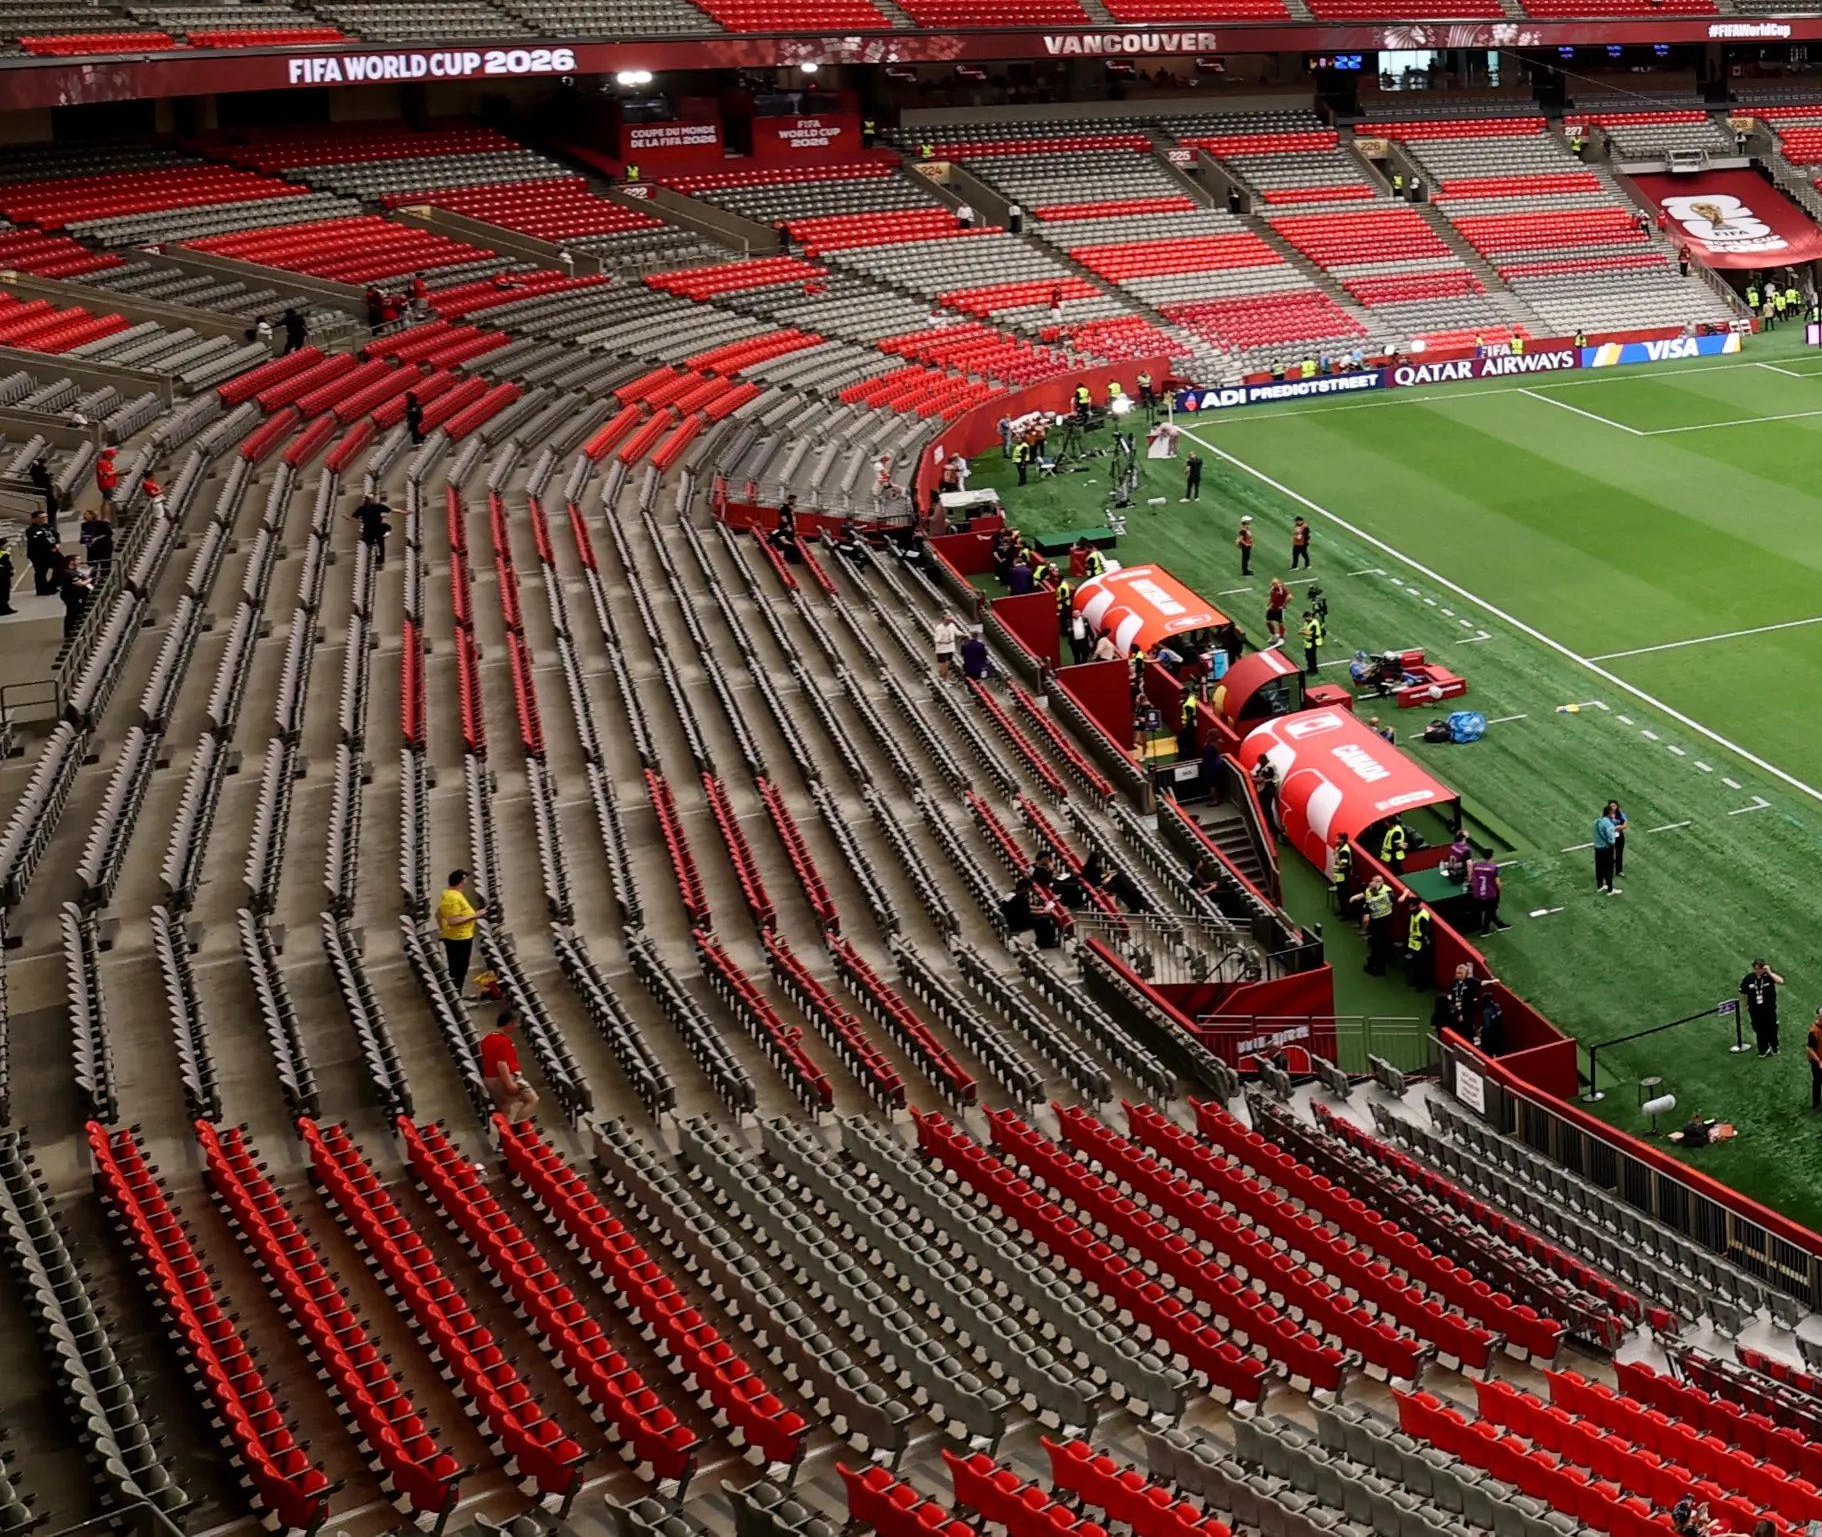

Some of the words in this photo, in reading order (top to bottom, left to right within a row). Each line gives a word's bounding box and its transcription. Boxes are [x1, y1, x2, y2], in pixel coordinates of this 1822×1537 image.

[1708, 23, 1791, 38] #FIFAWorldCup
[1043, 33, 1217, 54] VANCOUVER
[288, 58, 342, 84] FIFA
[344, 54, 427, 82] WORLD
[430, 52, 481, 77] CUP
[484, 48, 575, 74] 2026
[631, 128, 664, 139] COUPE
[665, 128, 680, 136] DU
[680, 126, 716, 136] MONDE
[778, 129, 818, 139] WORLD
[820, 128, 841, 137] CUP
[1564, 126, 1583, 136] 227
[630, 139, 644, 148] DE
[646, 138, 660, 147] LA
[660, 136, 682, 146] FIFA
[683, 134, 717, 144] 2026
[790, 138, 829, 148] 2026
[1168, 150, 1191, 162] 225
[1643, 337, 1699, 361] VISA
[1394, 361, 1473, 386] QATAR
[1481, 350, 1574, 376] AIRWAYS
[1200, 388, 1247, 409] ADI
[1250, 374, 1379, 401] PREDICTSTREET
